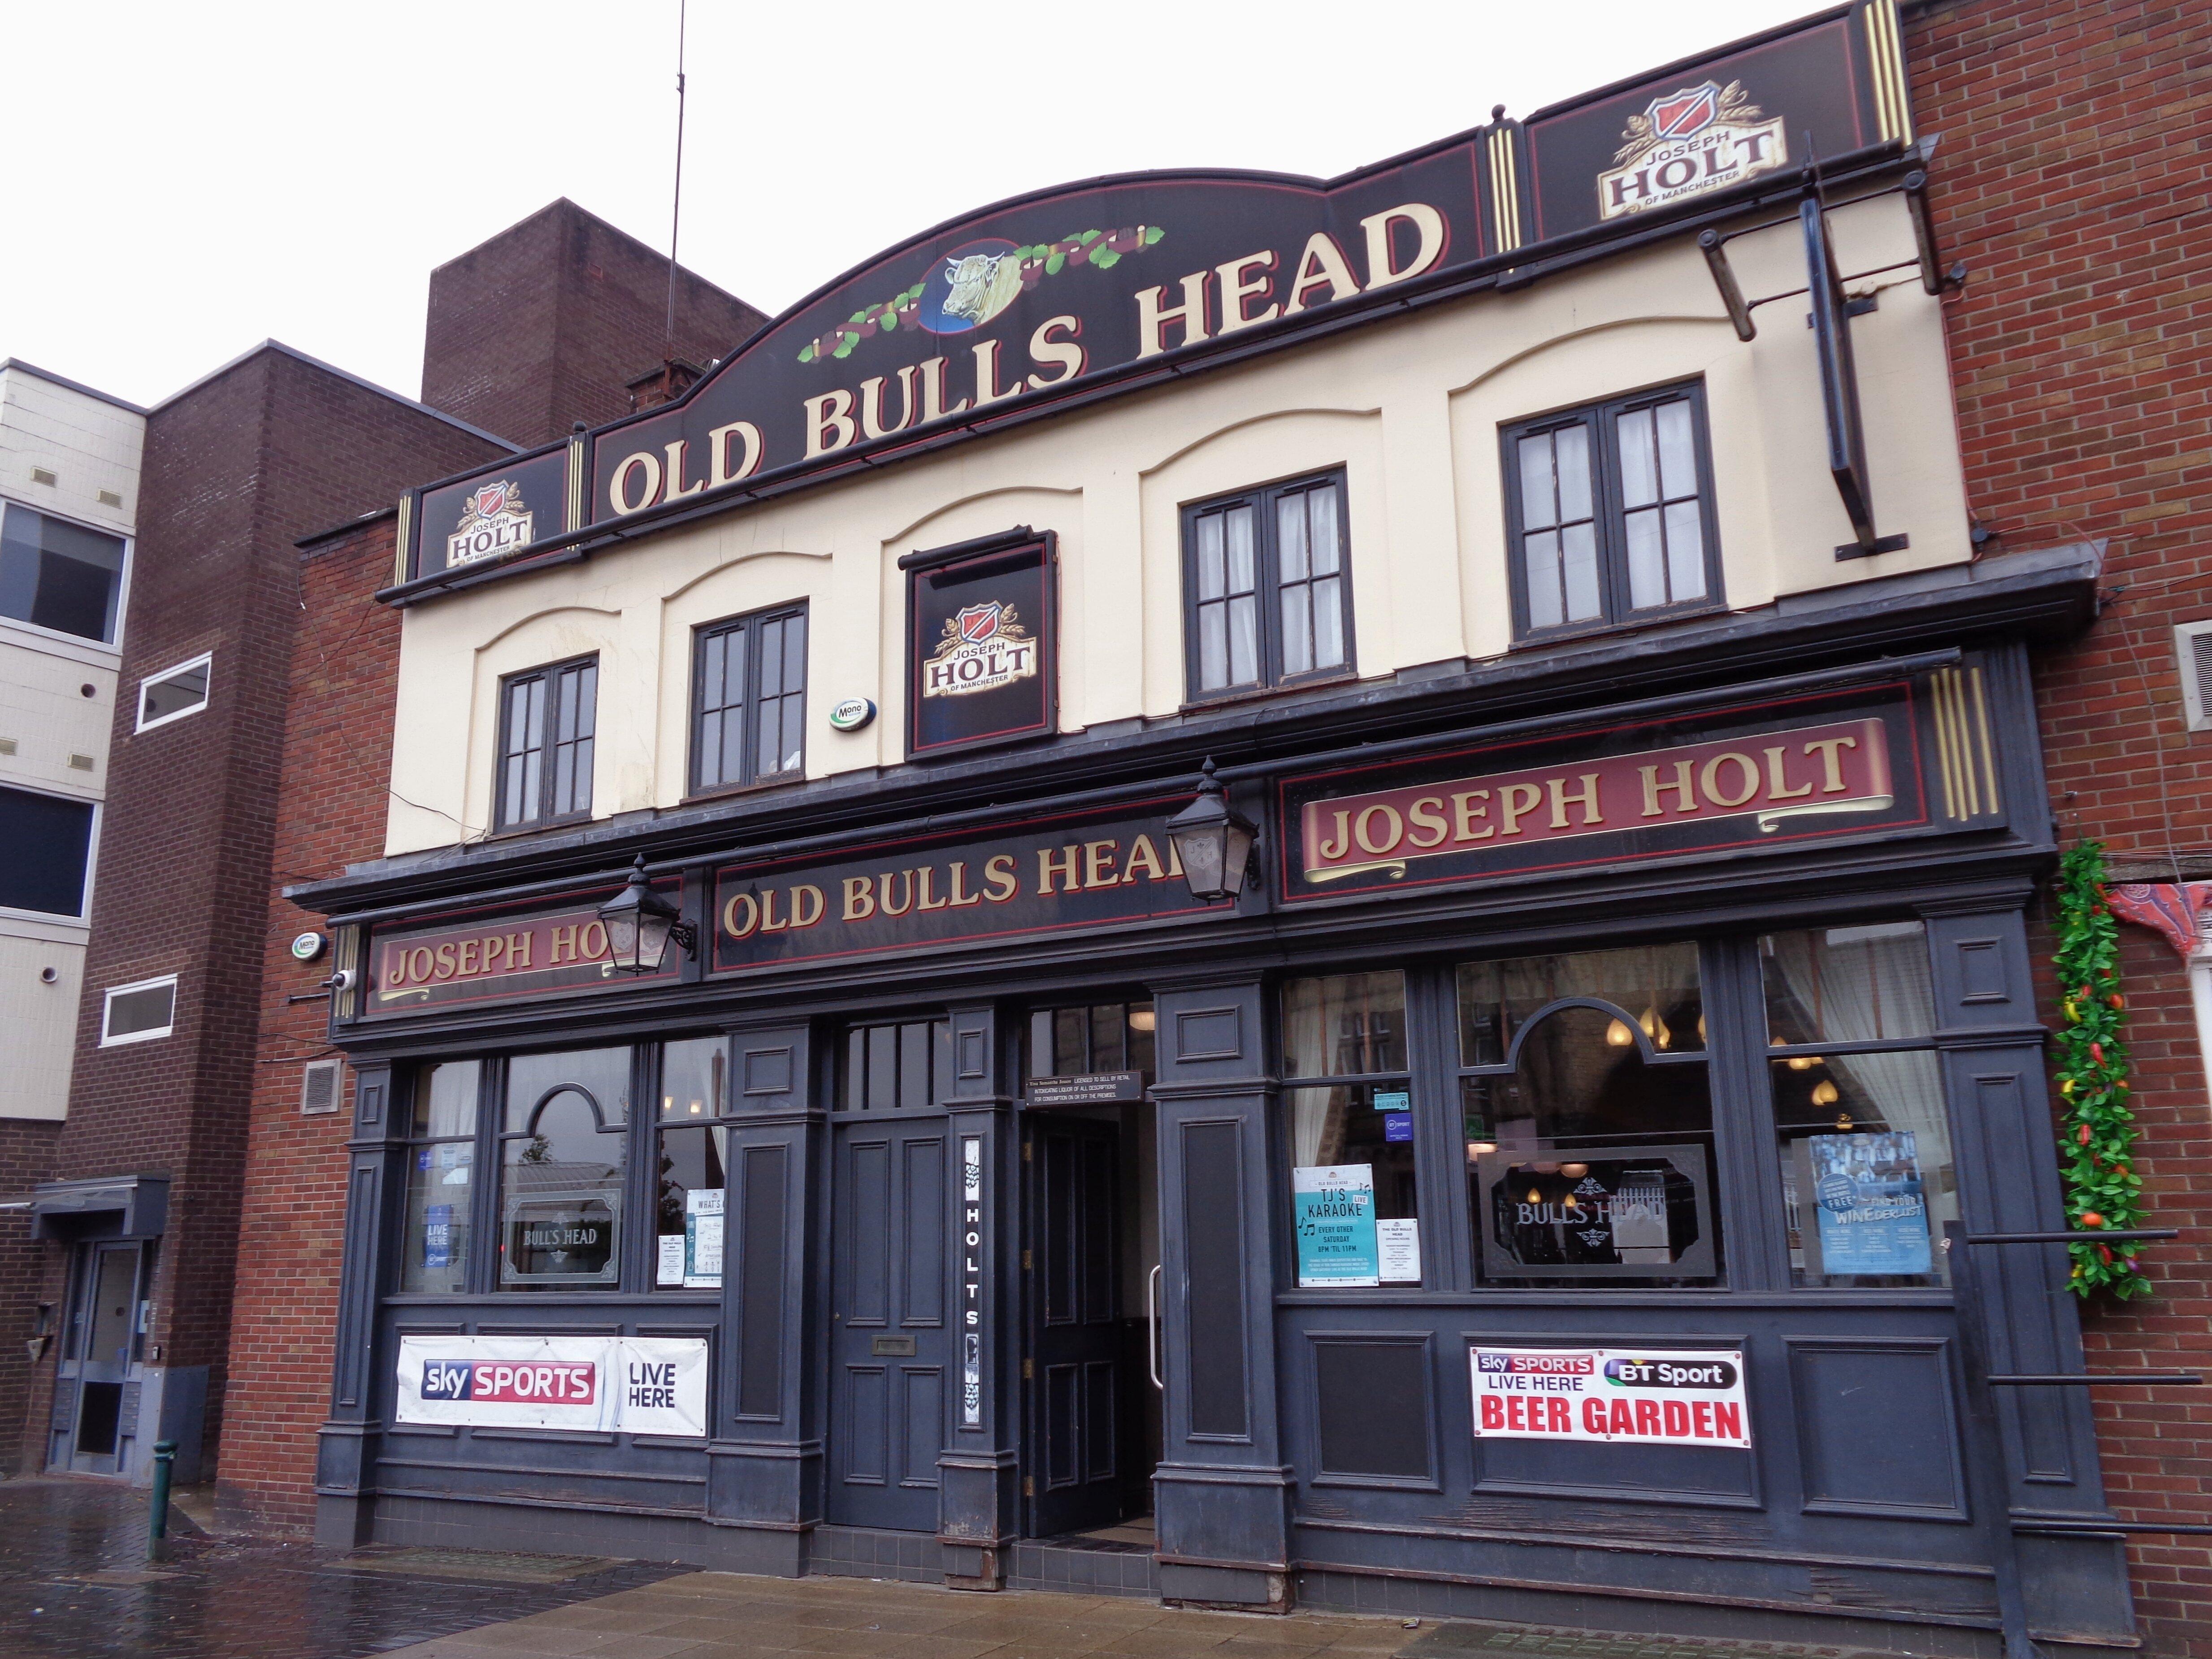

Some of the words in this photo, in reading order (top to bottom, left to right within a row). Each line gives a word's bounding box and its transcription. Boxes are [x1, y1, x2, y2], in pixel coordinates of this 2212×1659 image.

[1646, 130, 1731, 166] JOSEPH
[1609, 130, 1775, 207] HOLT
[1645, 195, 1658, 205] OF
[1661, 170, 1740, 200] MANCHESTER
[610, 421, 763, 515] OLD
[802, 315, 1085, 460] BULLS
[1134, 203, 1447, 359] HEAD
[470, 516, 509, 534] JOSEPH
[452, 520, 527, 560] HOLT
[474, 545, 510, 560] MANCHESTER
[954, 642, 1005, 660] JOSEPH
[931, 646, 1030, 688] HOLT
[961, 674, 1008, 689] MANCHESTER
[838, 705, 862, 718] Mono
[1319, 772, 1605, 860] JOSEPH
[1638, 736, 1856, 818] HOLT
[723, 883, 824, 938] OLD
[841, 853, 1018, 922] BULLS
[299, 940, 315, 950] Mono
[389, 930, 534, 985] JOSEPH
[698, 1200, 720, 1209] WHAT'S
[1321, 1188, 1345, 1202] TJ'S
[1308, 1203, 1362, 1218] KARAOKE
[1516, 1202, 1588, 1225] BULLS
[428, 1224, 448, 1235] LIVE
[523, 1230, 560, 1245] BULL'S
[562, 1228, 597, 1244] HEAD
[966, 1208, 980, 1325] HOLTS
[629, 1362, 676, 1386] LIVE
[1481, 1356, 1508, 1370] sky
[1513, 1357, 1591, 1372] SPORTS
[1618, 1364, 1655, 1382] BT
[1658, 1363, 1723, 1386] Sport
[426, 1361, 469, 1399] sky
[474, 1366, 590, 1398] SPORTS
[1488, 1375, 1527, 1390] LIVE
[1532, 1377, 1584, 1391] HERE
[629, 1387, 676, 1408] HERE
[1480, 1395, 1572, 1433] BEER
[1582, 1397, 1743, 1439] GARDEN
